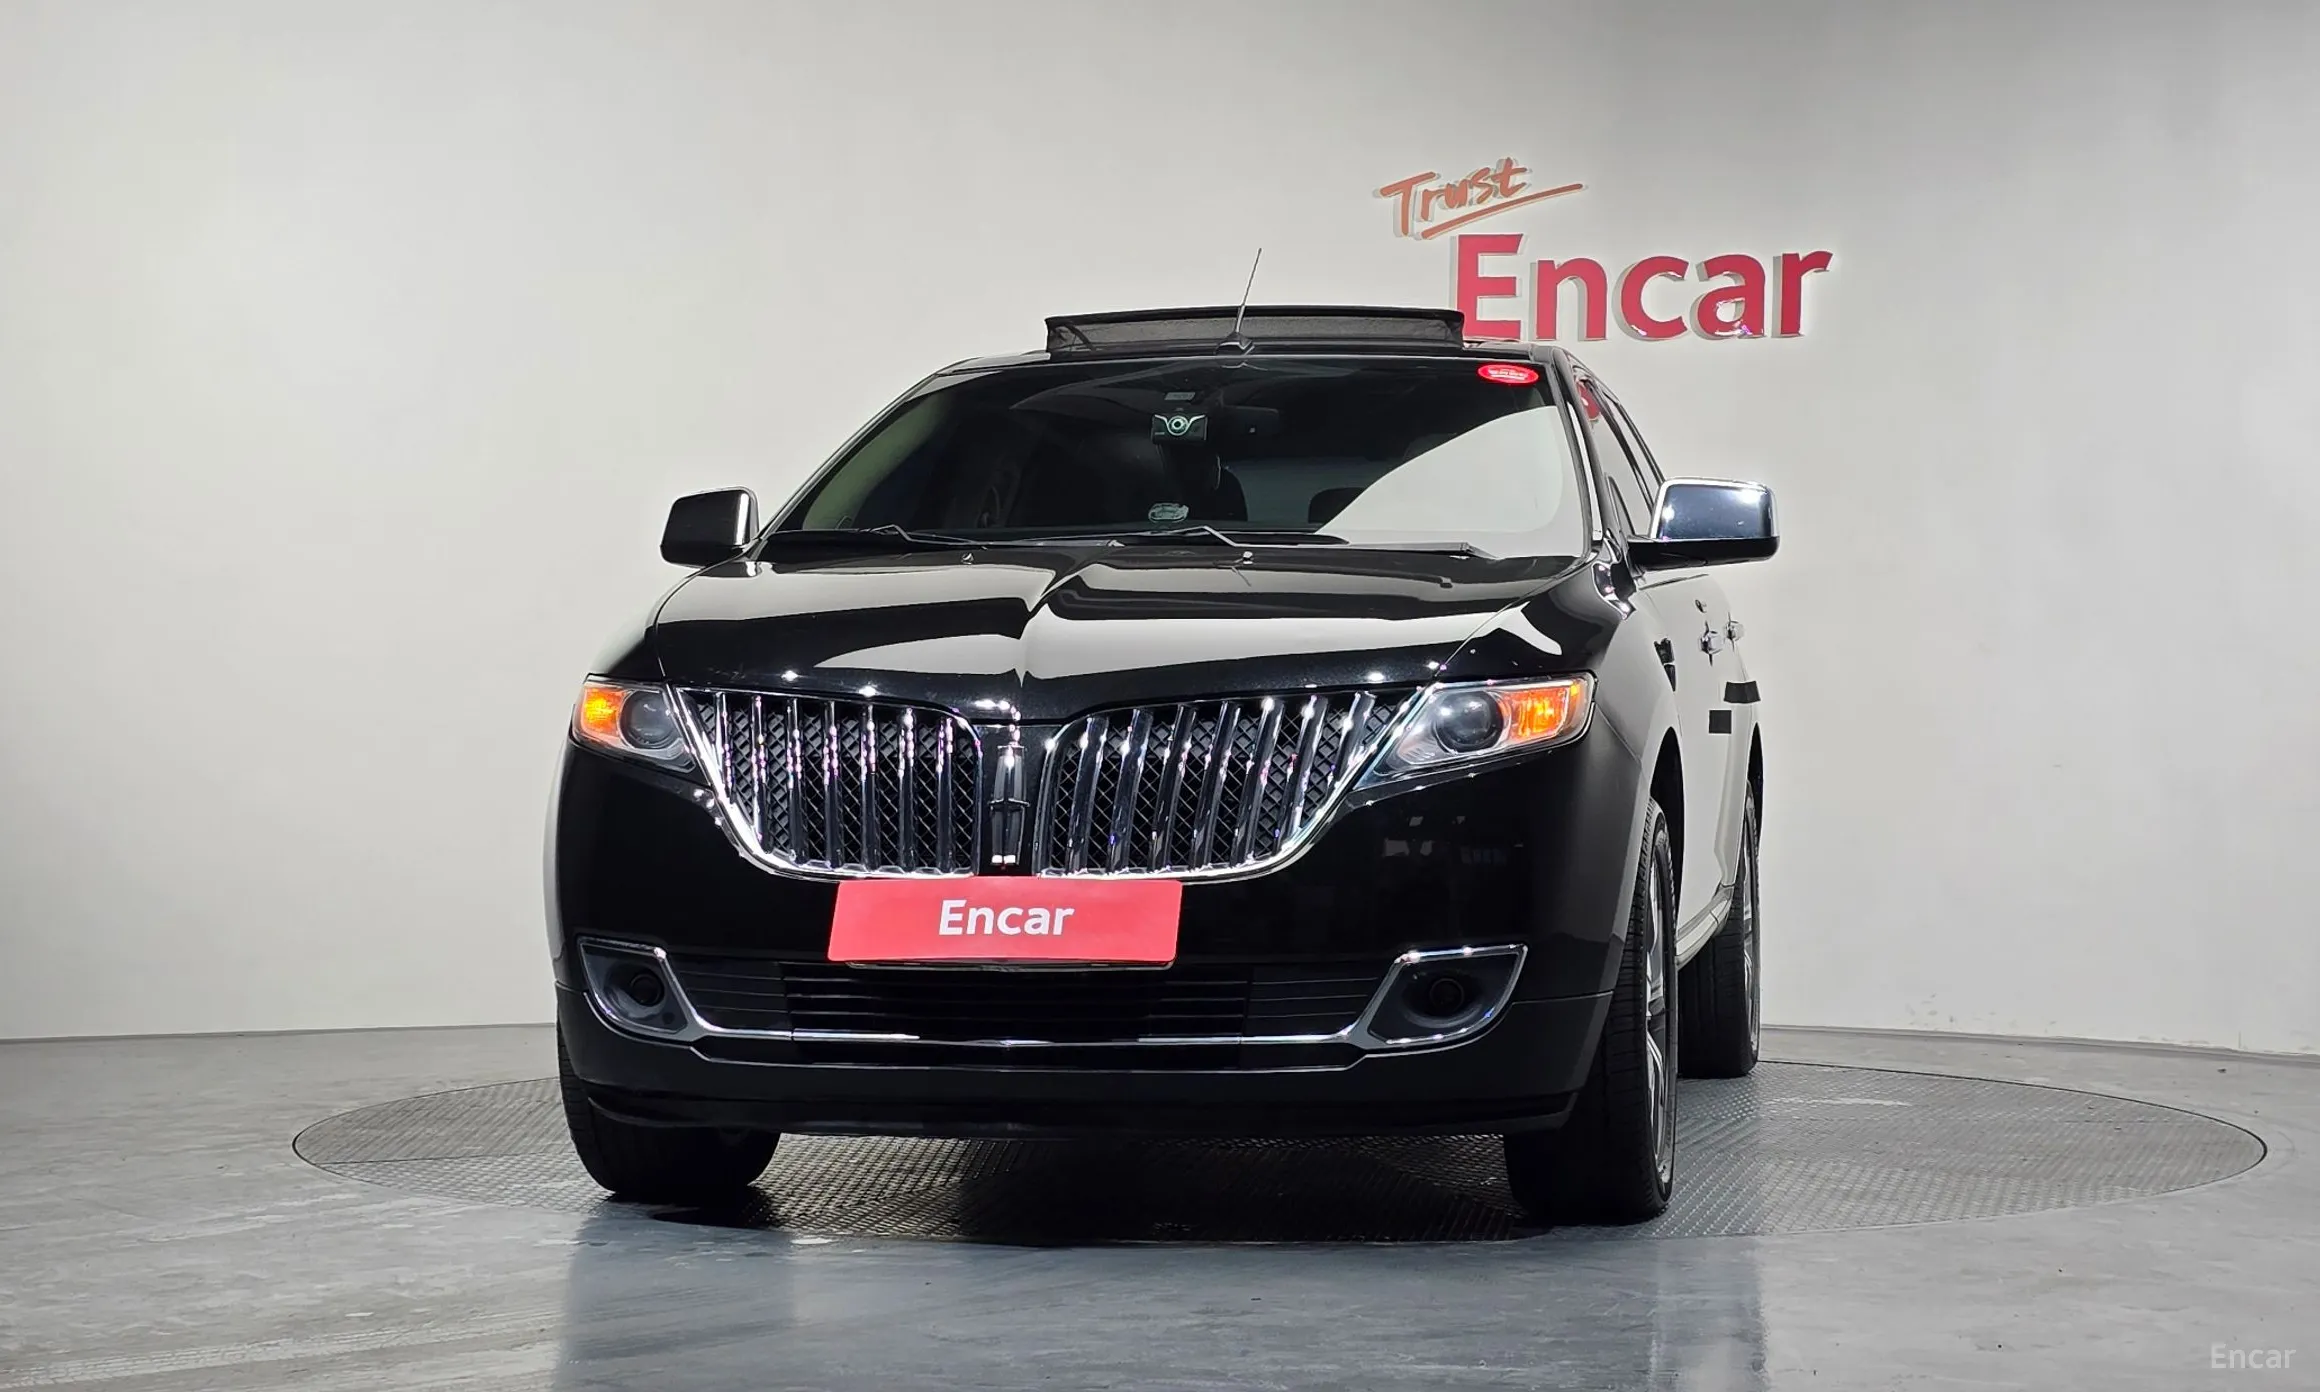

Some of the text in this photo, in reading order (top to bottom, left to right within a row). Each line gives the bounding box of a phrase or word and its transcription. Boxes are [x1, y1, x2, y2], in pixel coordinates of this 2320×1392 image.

[1378, 157, 1529, 236] Trust
[1454, 233, 1834, 341] Encar
[939, 899, 1075, 936] Encar
